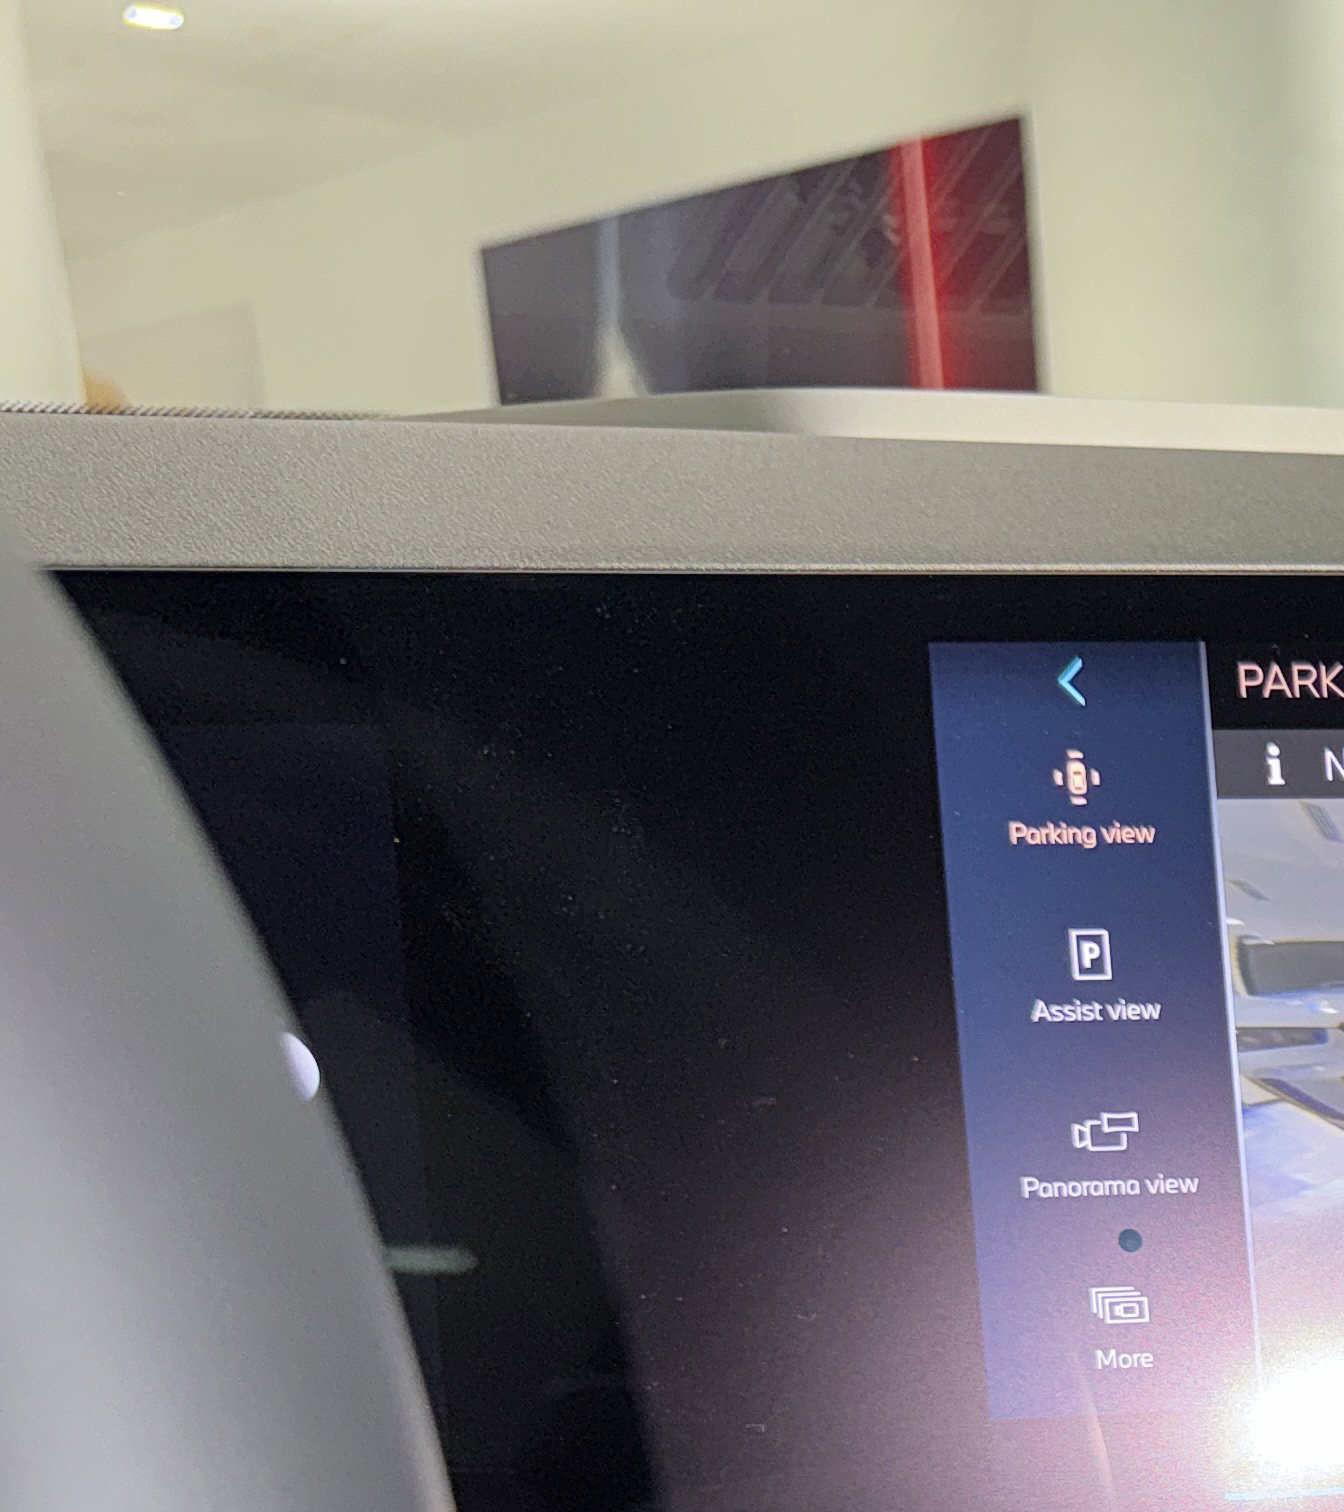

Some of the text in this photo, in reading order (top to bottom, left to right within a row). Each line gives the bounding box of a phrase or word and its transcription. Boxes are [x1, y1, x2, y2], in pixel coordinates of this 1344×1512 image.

[1009, 821, 1156, 849] Parking view
[1031, 999, 1161, 1022] Assist view
[1020, 1173, 1199, 1198] Panorama view
[1096, 1350, 1153, 1369] More
